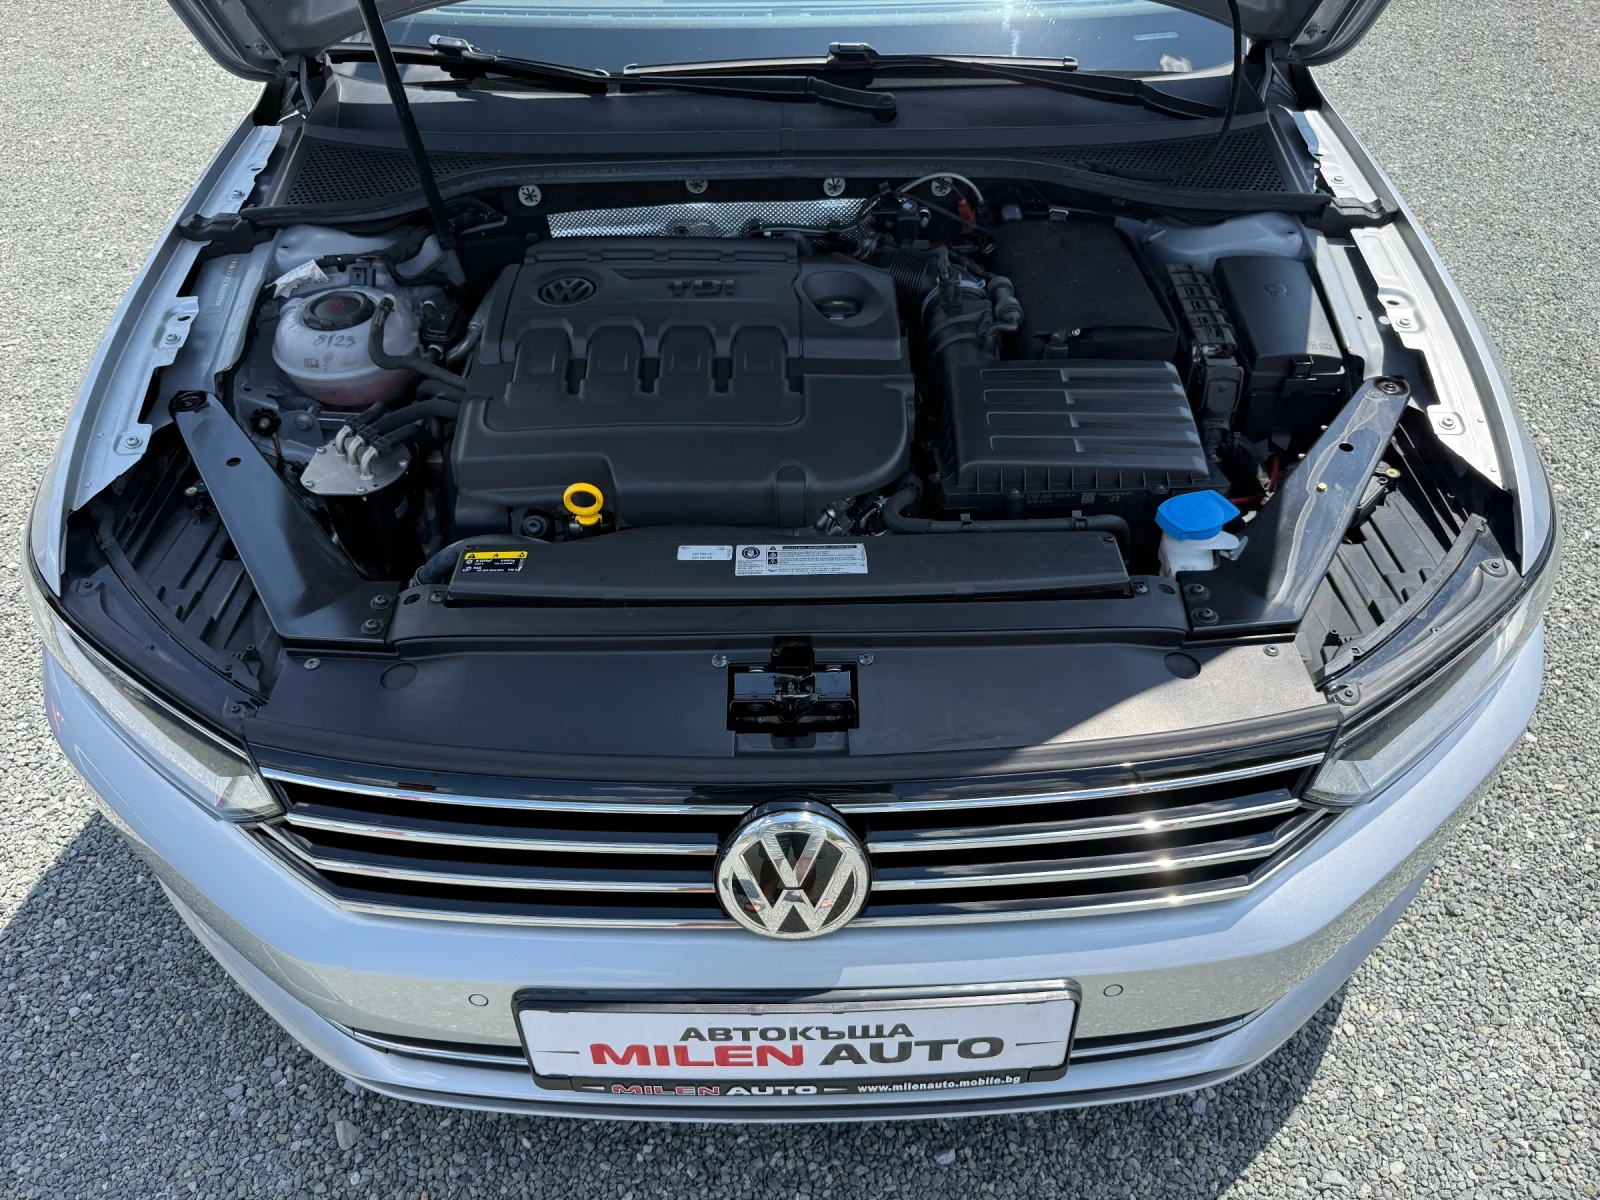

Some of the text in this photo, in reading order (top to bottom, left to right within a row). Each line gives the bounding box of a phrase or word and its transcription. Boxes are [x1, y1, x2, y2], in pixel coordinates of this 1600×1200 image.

[667, 280, 735, 296] TDI
[590, 1036, 1004, 1067] MILEN AUTO
[611, 1074, 1021, 1096] MILEN AUTO www.milenauto.mobile.bg
